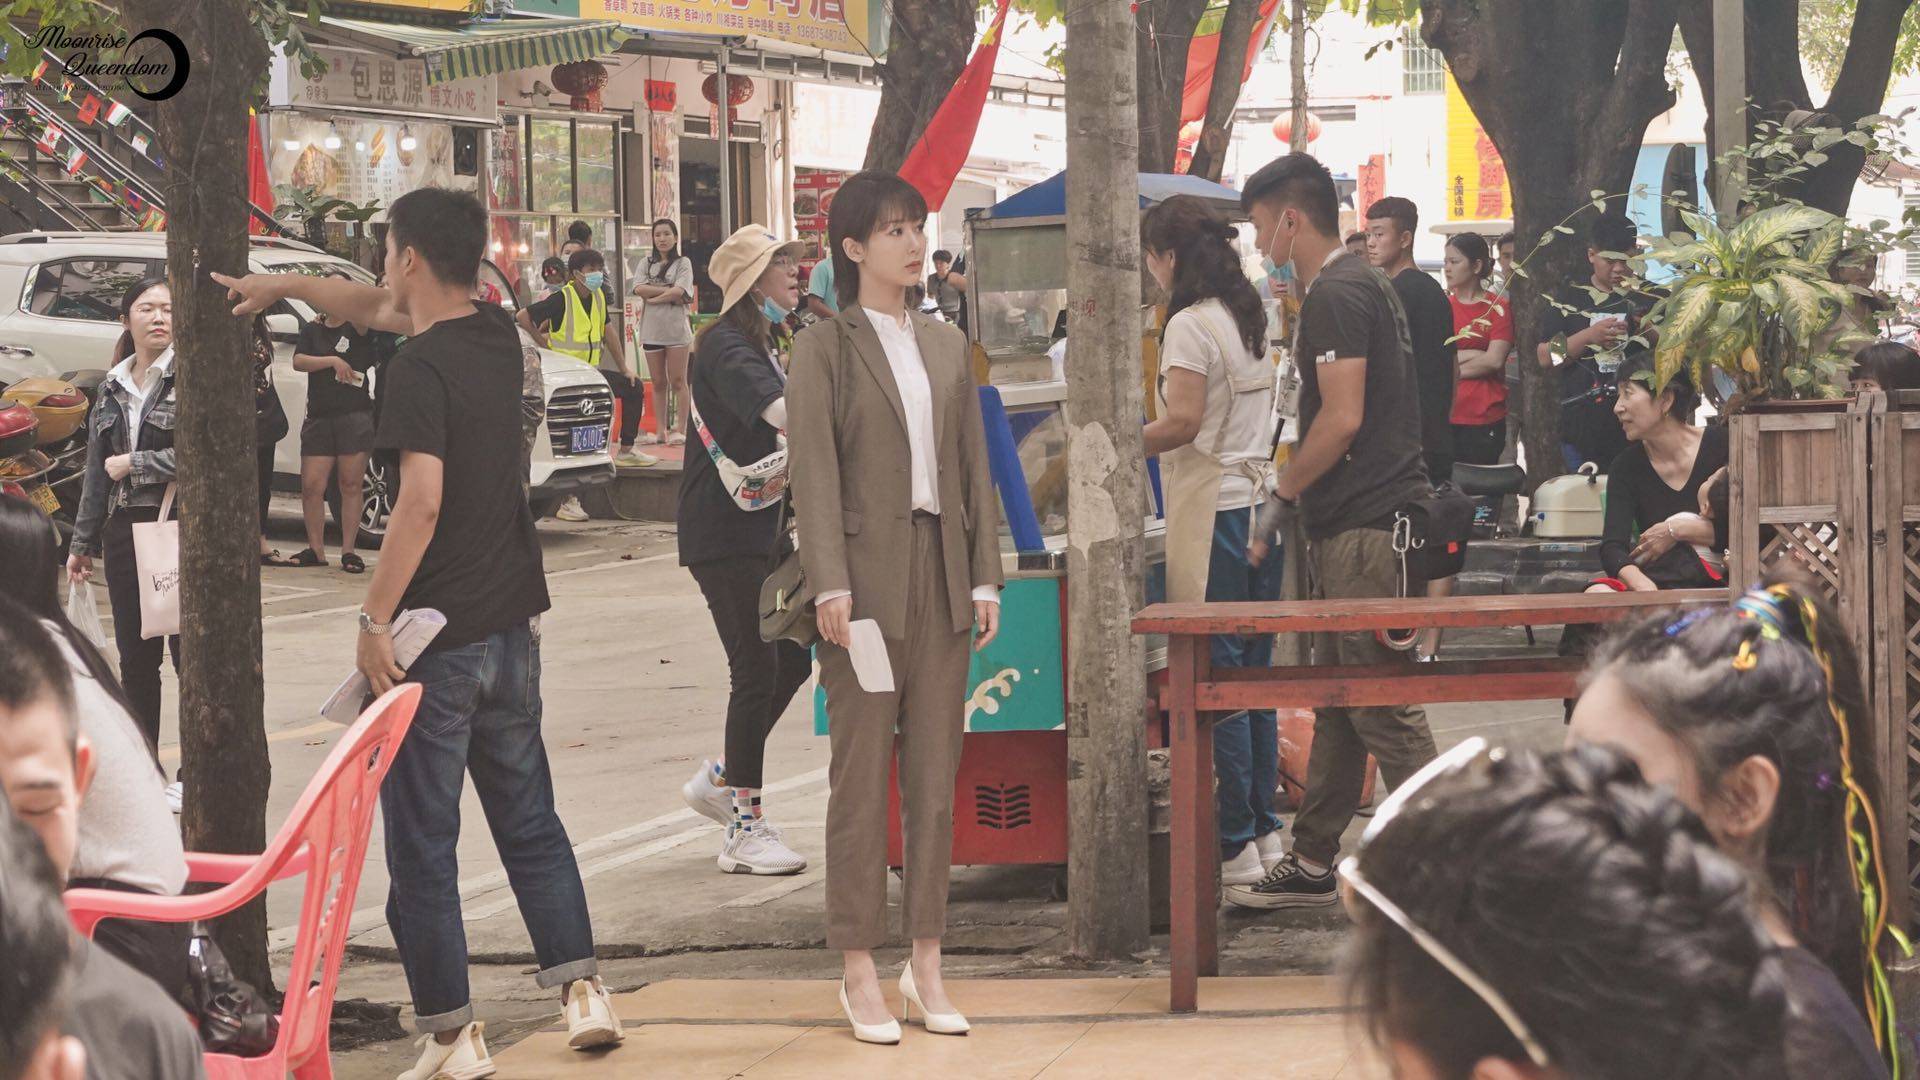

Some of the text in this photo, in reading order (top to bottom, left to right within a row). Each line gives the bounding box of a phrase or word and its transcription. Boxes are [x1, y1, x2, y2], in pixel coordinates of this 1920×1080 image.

[684, 8, 712, 24] 各种小炒
[351, 56, 423, 106] 包思源
[1454, 175, 1464, 216] 全国连锁
